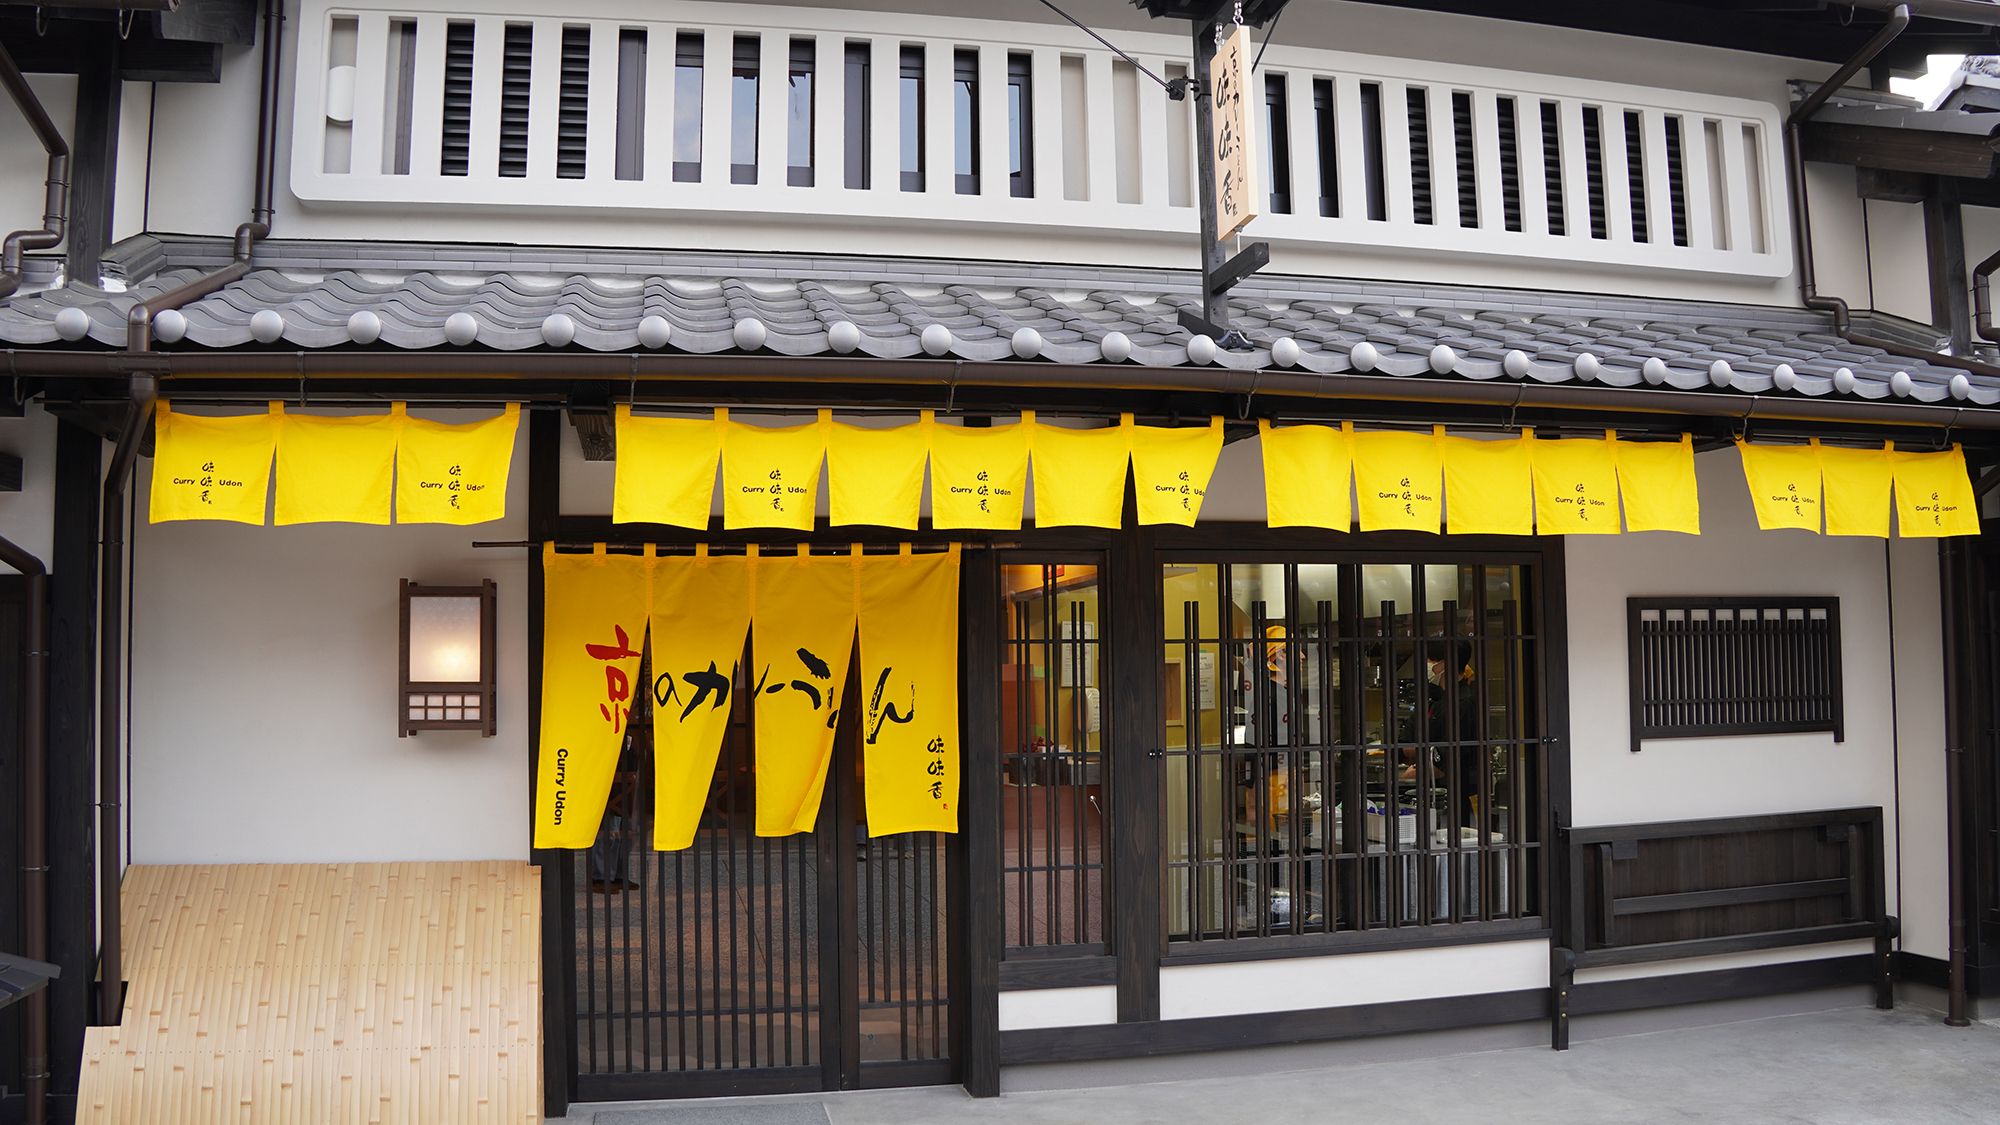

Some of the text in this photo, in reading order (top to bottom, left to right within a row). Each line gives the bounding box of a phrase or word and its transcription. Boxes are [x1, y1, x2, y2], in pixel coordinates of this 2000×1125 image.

[1216, 61, 1234, 215] 味味香
[219, 479, 243, 487] Udon
[420, 481, 485, 492] Curry Udon
[742, 485, 765, 493] Curry
[1155, 485, 1205, 497] Curry Udo
[1415, 494, 1432, 502] Udon
[926, 734, 946, 800] 味味香
[554, 748, 568, 827] Curry Udon
